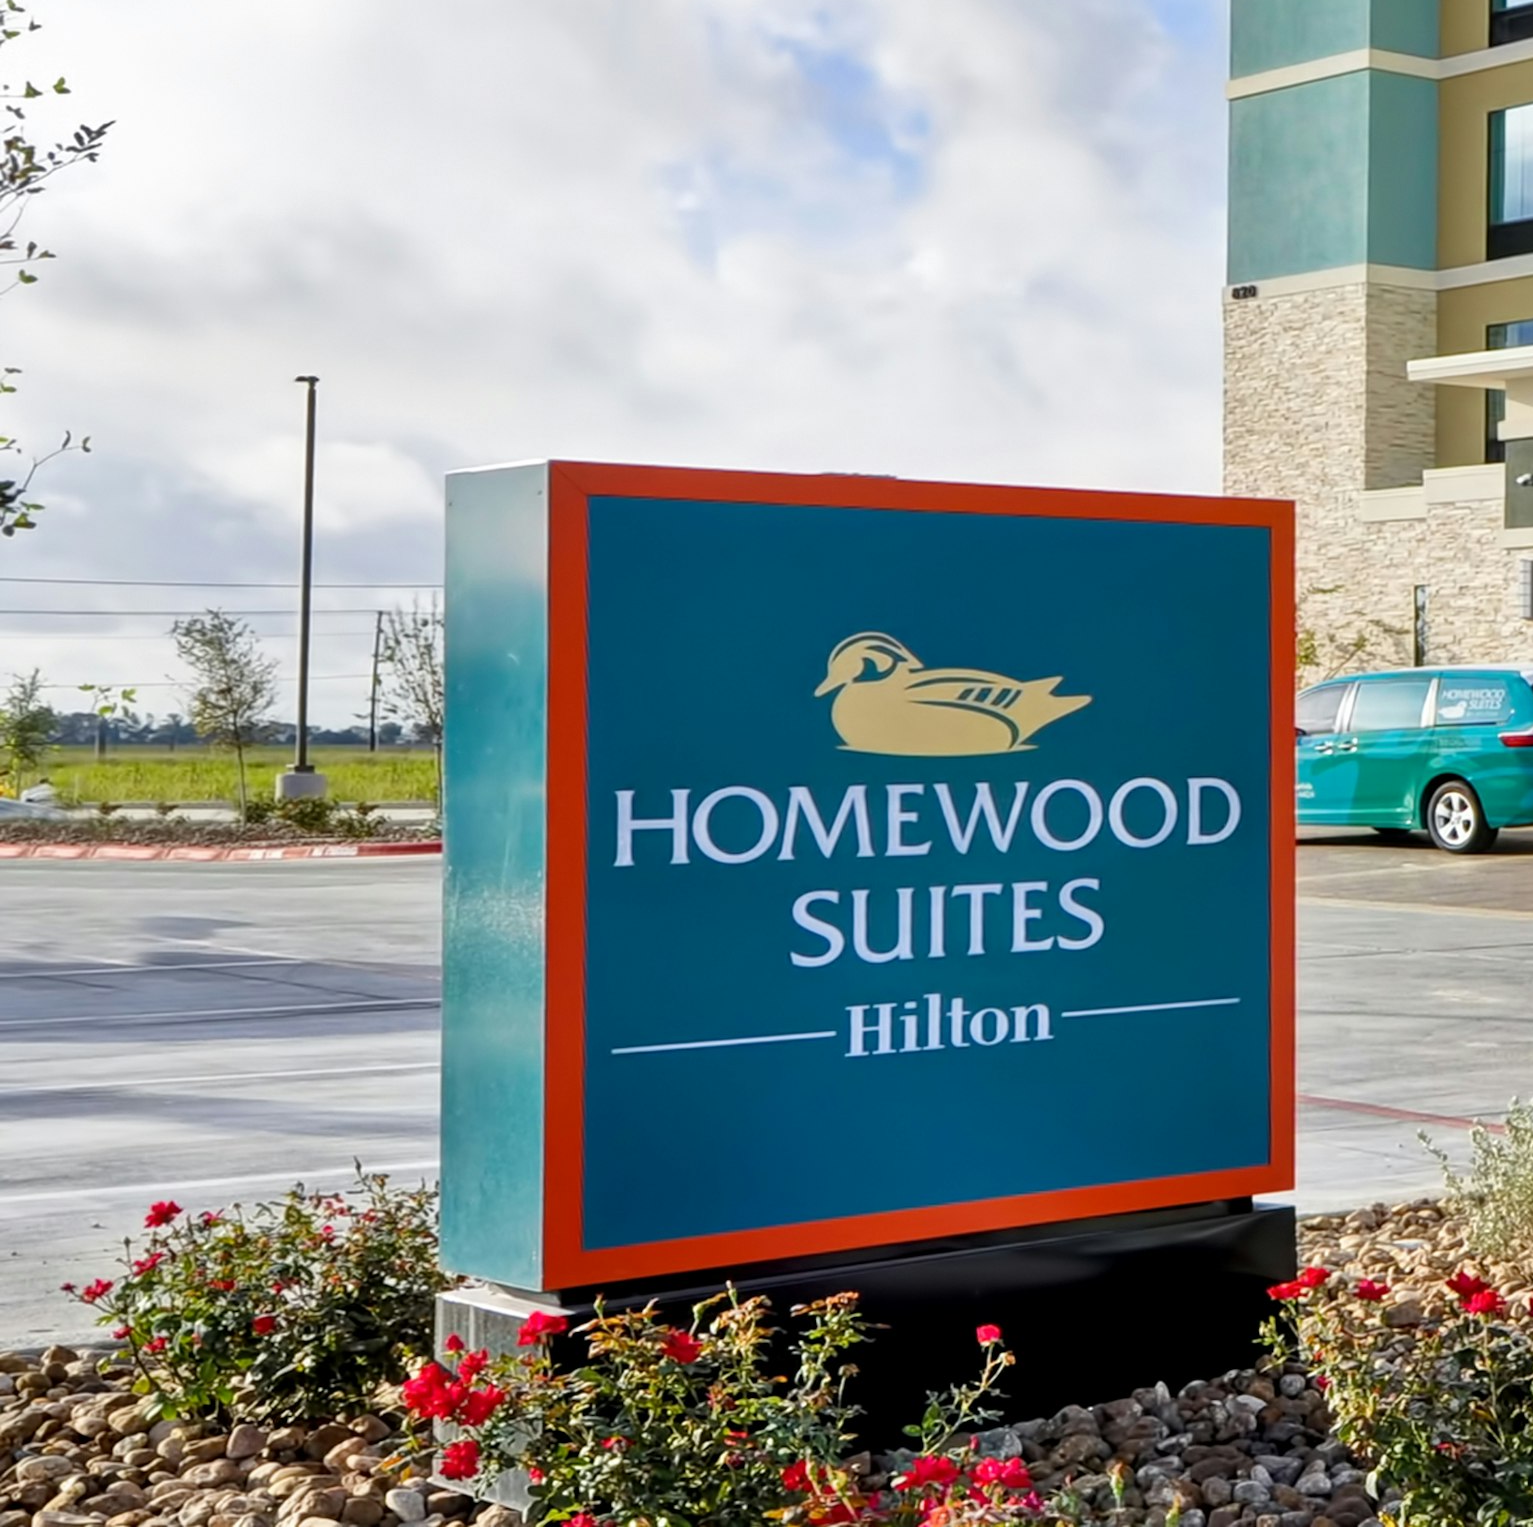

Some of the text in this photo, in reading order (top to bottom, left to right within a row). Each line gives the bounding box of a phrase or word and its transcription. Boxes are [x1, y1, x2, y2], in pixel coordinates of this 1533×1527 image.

[613, 777, 1241, 866] HOMEWOOD
[790, 878, 1104, 967] SUITES
[844, 993, 1054, 1057] Hilton
